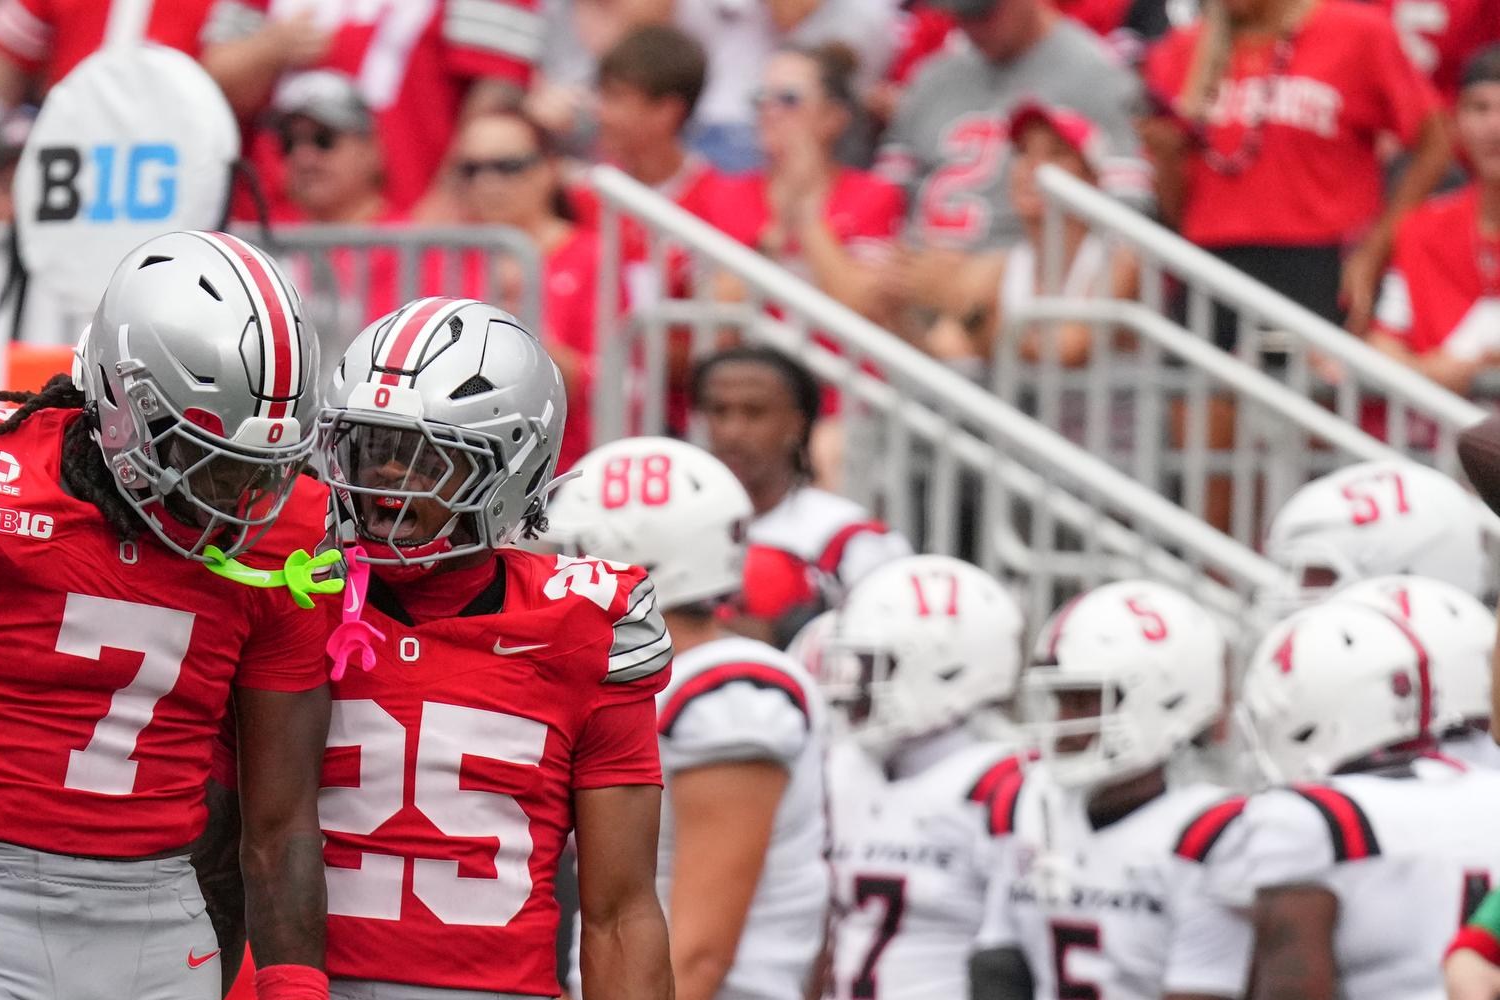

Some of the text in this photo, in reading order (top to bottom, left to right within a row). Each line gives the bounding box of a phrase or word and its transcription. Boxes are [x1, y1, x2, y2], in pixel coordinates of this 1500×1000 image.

[603, 454, 672, 509] 88
[1340, 471, 1409, 526] 57
[909, 571, 959, 618] 17
[55, 592, 196, 796] 7
[317, 699, 548, 927] 25
